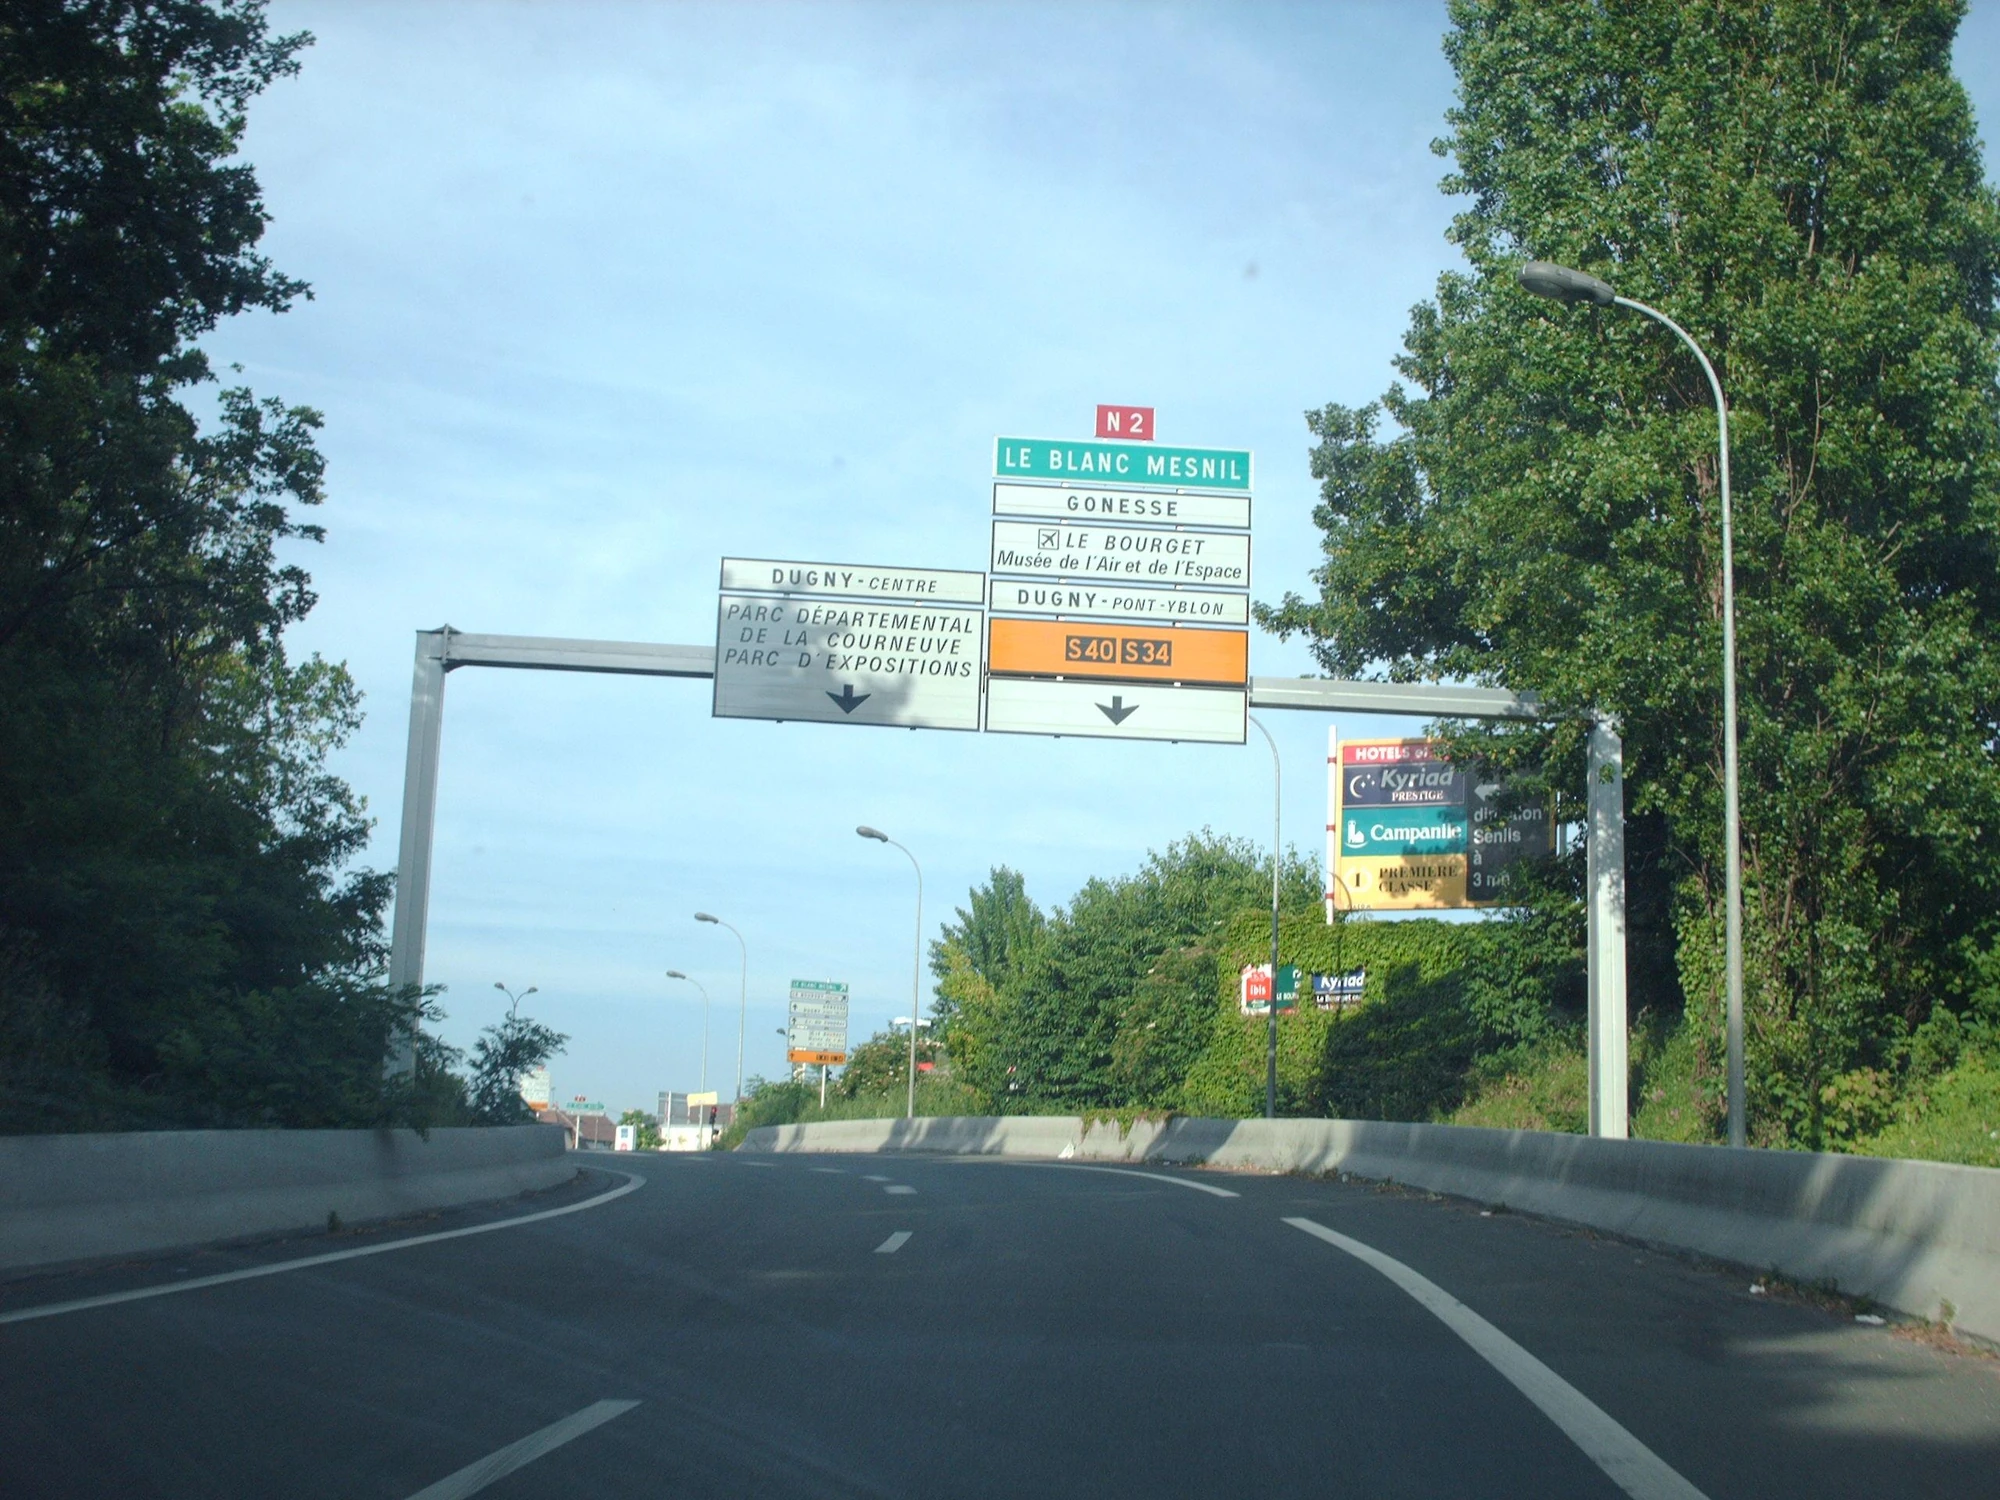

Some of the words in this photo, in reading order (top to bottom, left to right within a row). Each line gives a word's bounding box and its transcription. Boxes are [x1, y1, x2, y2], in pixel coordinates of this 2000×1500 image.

[1004, 446, 1031, 469] LE
[1050, 450, 1130, 474] BLANC
[1146, 454, 1242, 480] MESNIL
[1066, 495, 1179, 517] GONESSE
[1066, 531, 1089, 550] LE
[1104, 534, 1206, 556] BOURGET
[997, 549, 1053, 569] Musée
[1059, 553, 1080, 571] de
[1125, 557, 1142, 574] et
[1148, 558, 1169, 575] de
[1174, 559, 1243, 582] l'Espace
[726, 603, 785, 624] PARC
[795, 605, 974, 635] DÉPARTEMENTAL
[739, 626, 769, 645] DE
[783, 628, 809, 647] LA
[826, 631, 962, 656] COURNEUVE
[724, 647, 780, 667] PARC
[1355, 746, 1410, 760] HOTELS
[1380, 764, 1456, 792] Kyriad
[1391, 790, 1444, 802] PRESTIGE
[1369, 823, 1462, 845] Campanile
[1473, 827, 1522, 845] Senlis
[1472, 848, 1483, 866] à
[1378, 865, 1458, 879] PREMIERE
[1472, 871, 1482, 888] 3
[1378, 880, 1434, 892] CLASSE
[1249, 984, 1267, 996] ibis
